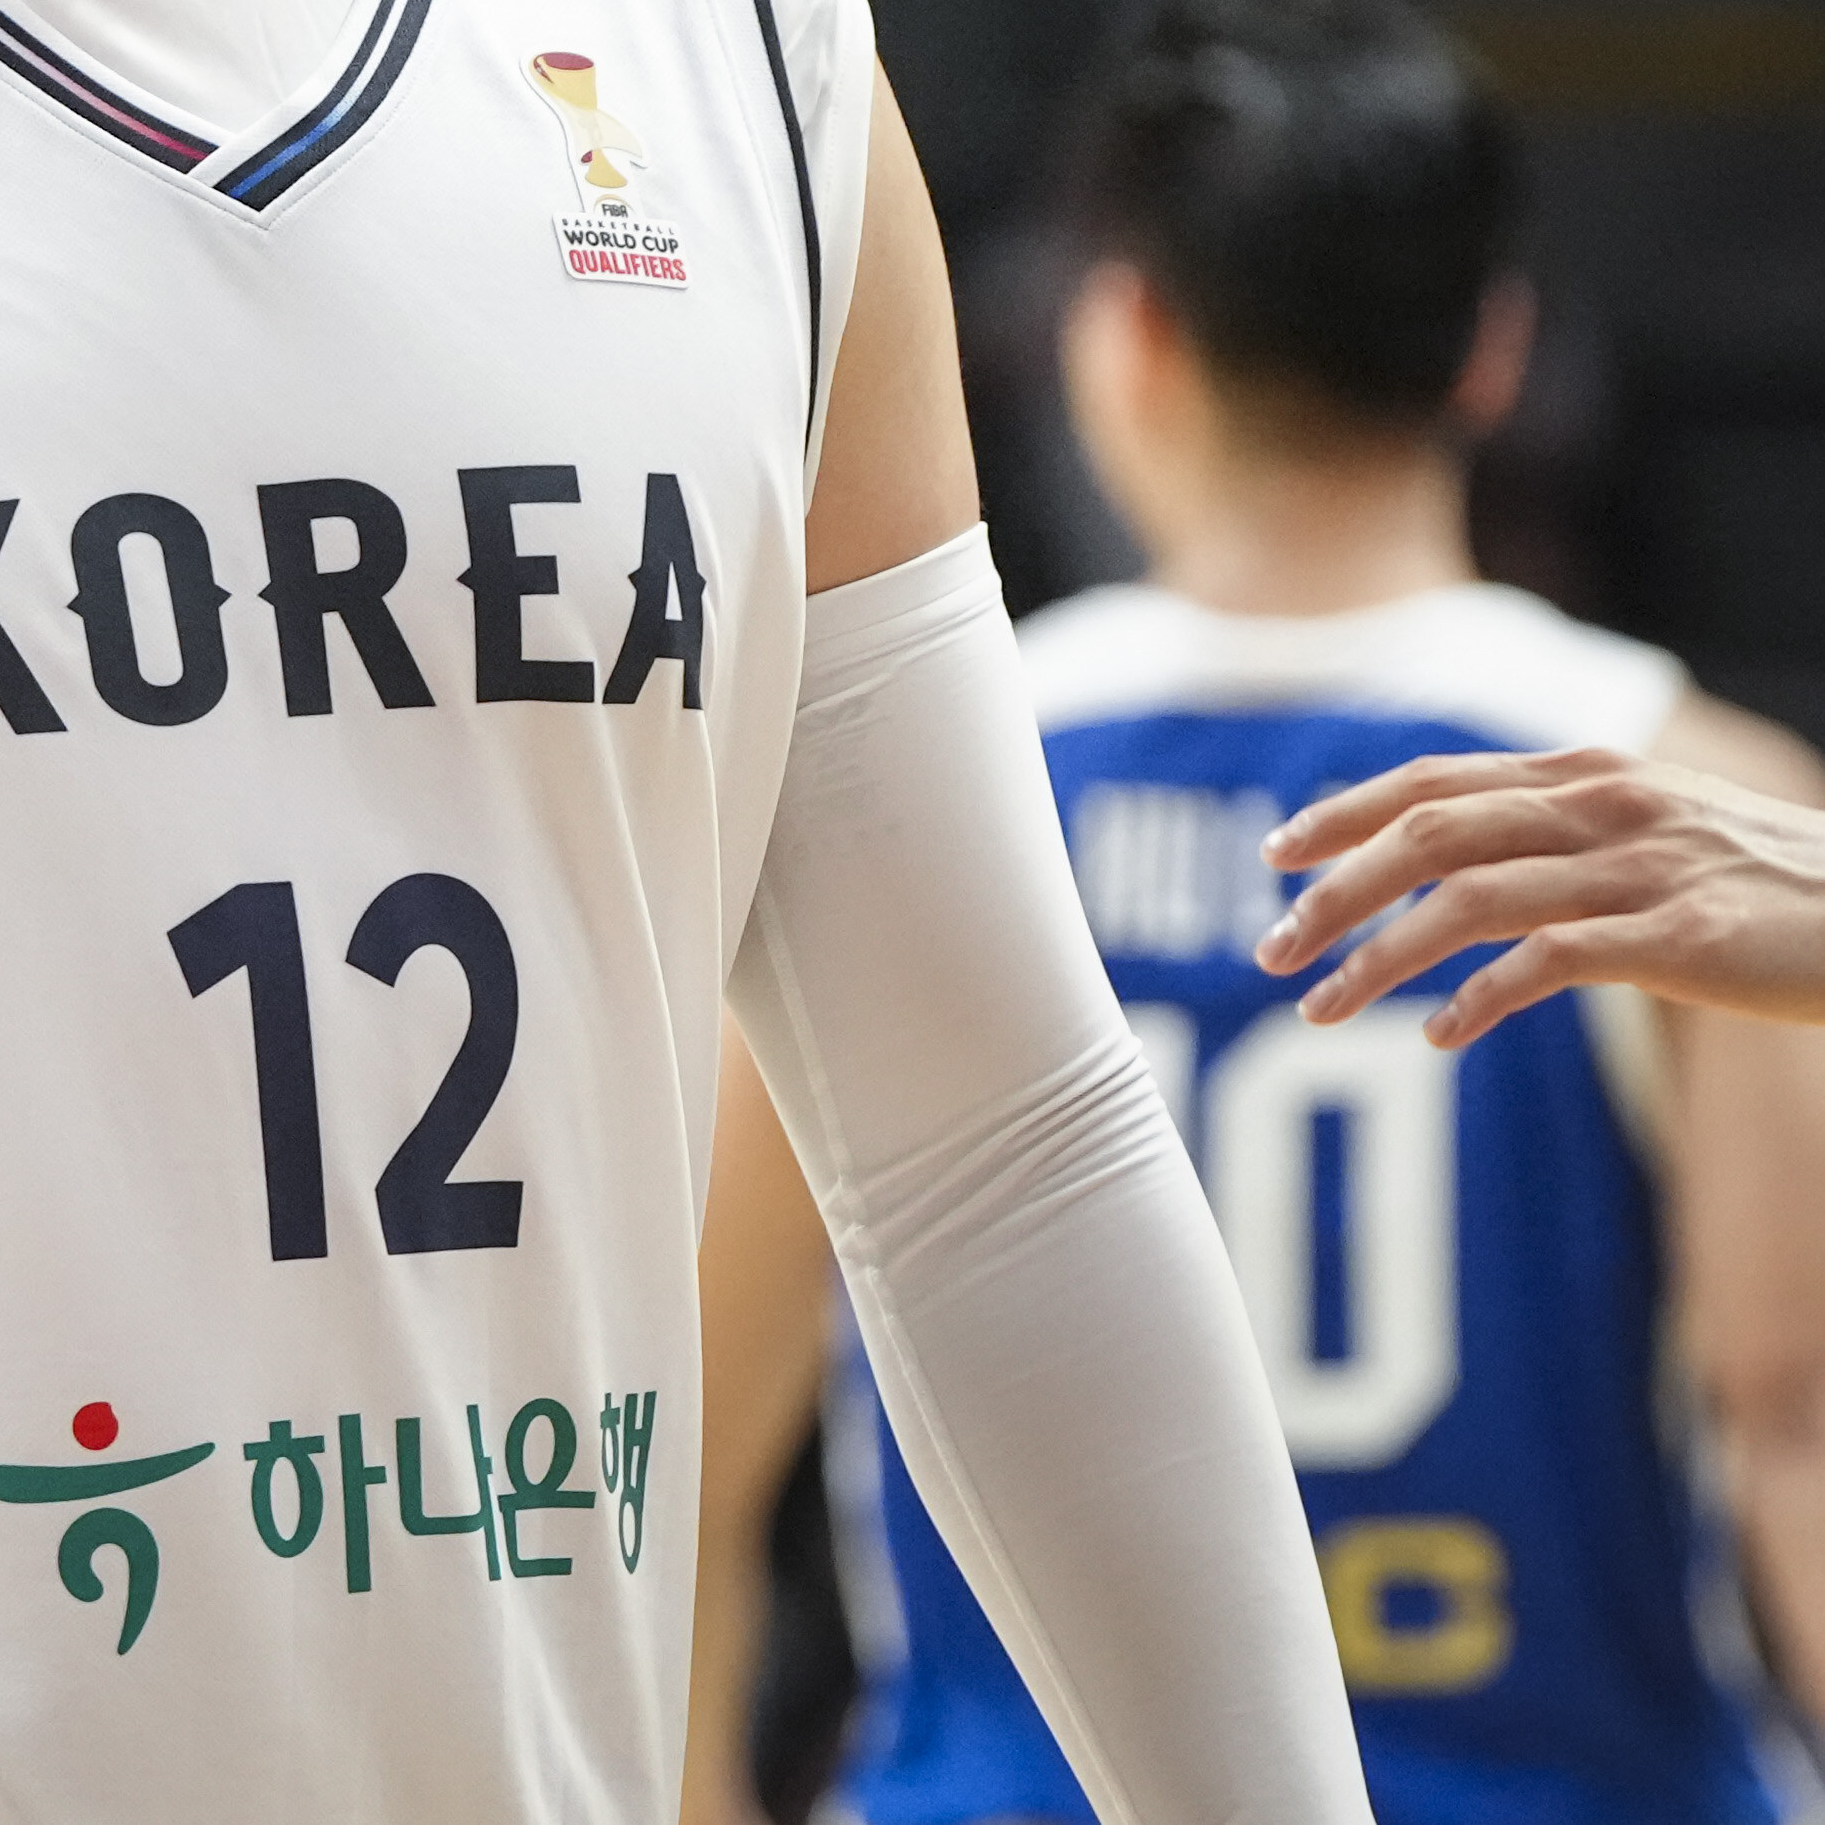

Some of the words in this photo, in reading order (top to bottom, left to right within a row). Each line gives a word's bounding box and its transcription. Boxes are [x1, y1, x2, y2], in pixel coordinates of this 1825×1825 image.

[561, 218, 675, 235] BASKETBALL
[601, 203, 629, 218] FIBA
[563, 229, 637, 249] WORLD
[641, 235, 679, 254] CUP
[568, 249, 687, 281] QUALIFIERS
[166, 872, 524, 1262] 12
[1122, 995, 1460, 1470] 0
[242, 1390, 658, 1595] 하나은행
